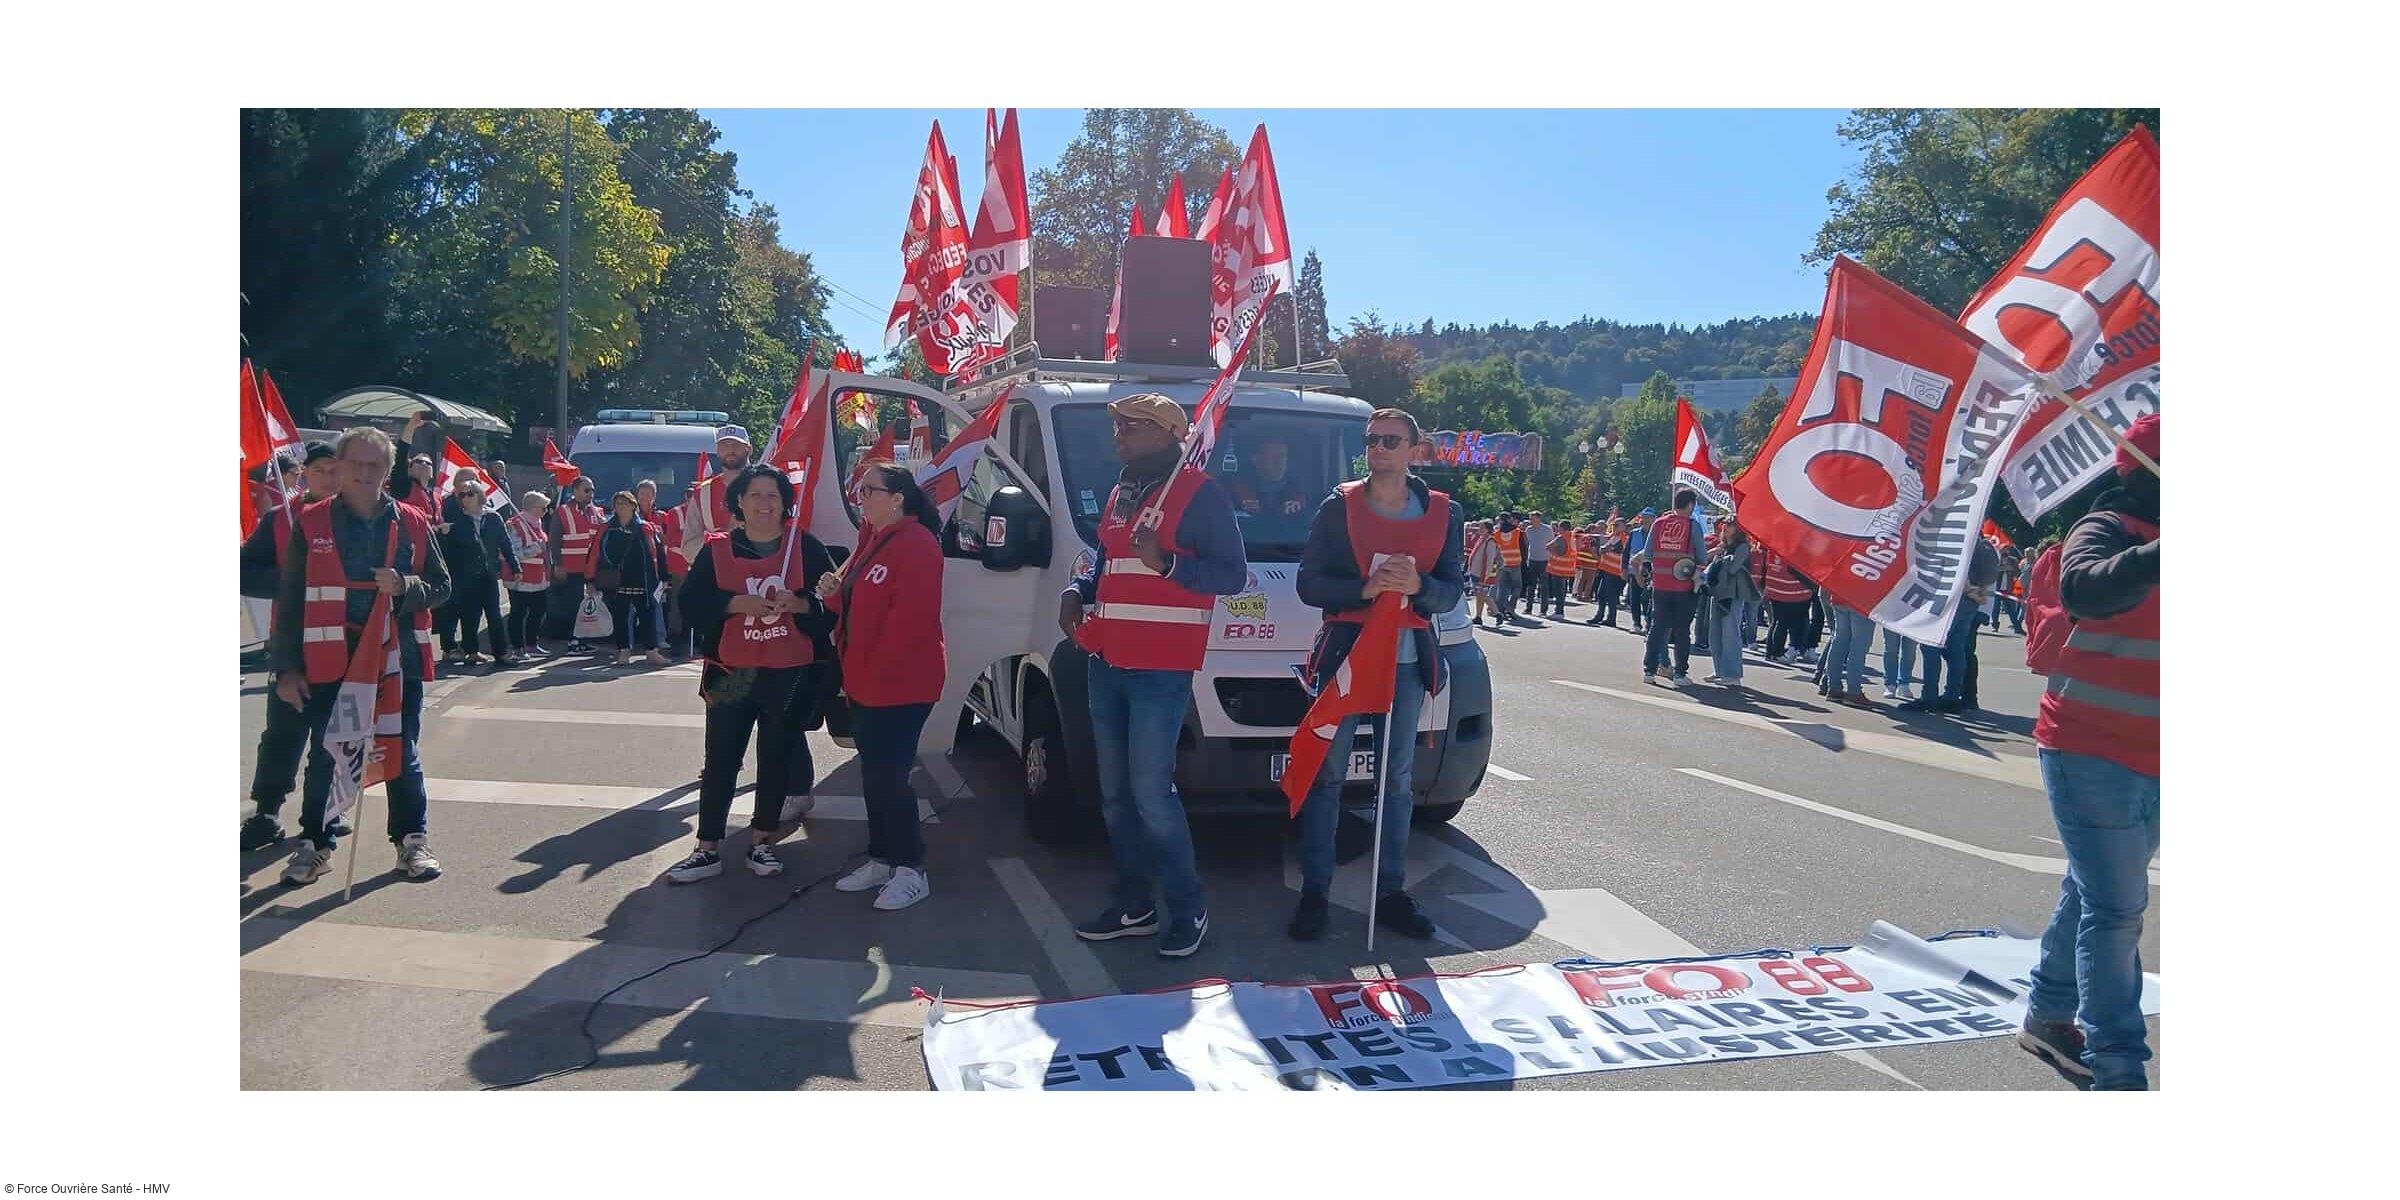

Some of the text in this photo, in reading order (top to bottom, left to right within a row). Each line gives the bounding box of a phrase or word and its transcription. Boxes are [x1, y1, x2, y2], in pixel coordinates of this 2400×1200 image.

[864, 563, 889, 585] FO
[1258, 623, 1276, 639] 88
[1562, 956, 1876, 1008] FO 88
[1309, 981, 1433, 1029] FO
